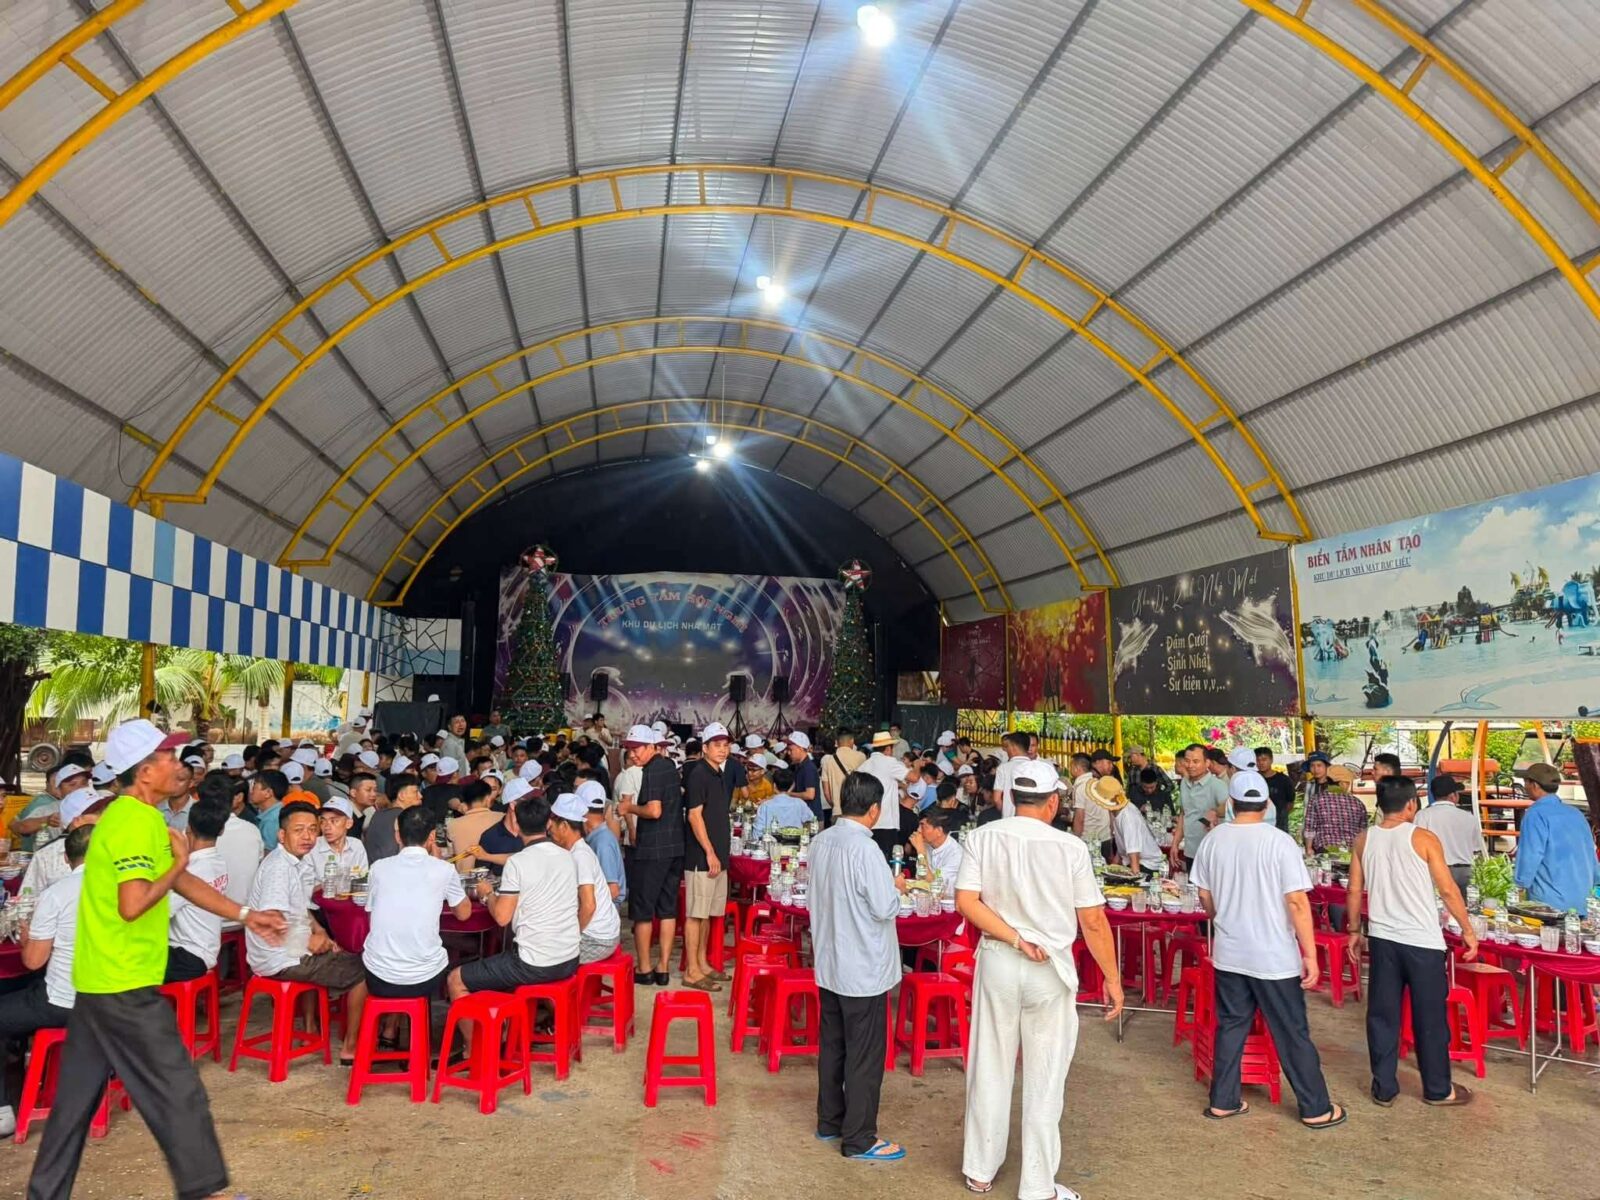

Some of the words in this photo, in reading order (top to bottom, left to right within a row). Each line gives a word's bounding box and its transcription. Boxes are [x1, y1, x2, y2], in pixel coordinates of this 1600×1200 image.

[1398, 534, 1421, 553] TẠO
[622, 620, 641, 628] KHU
[643, 620, 656, 629] DU
[1167, 653, 1187, 671] Sinh
